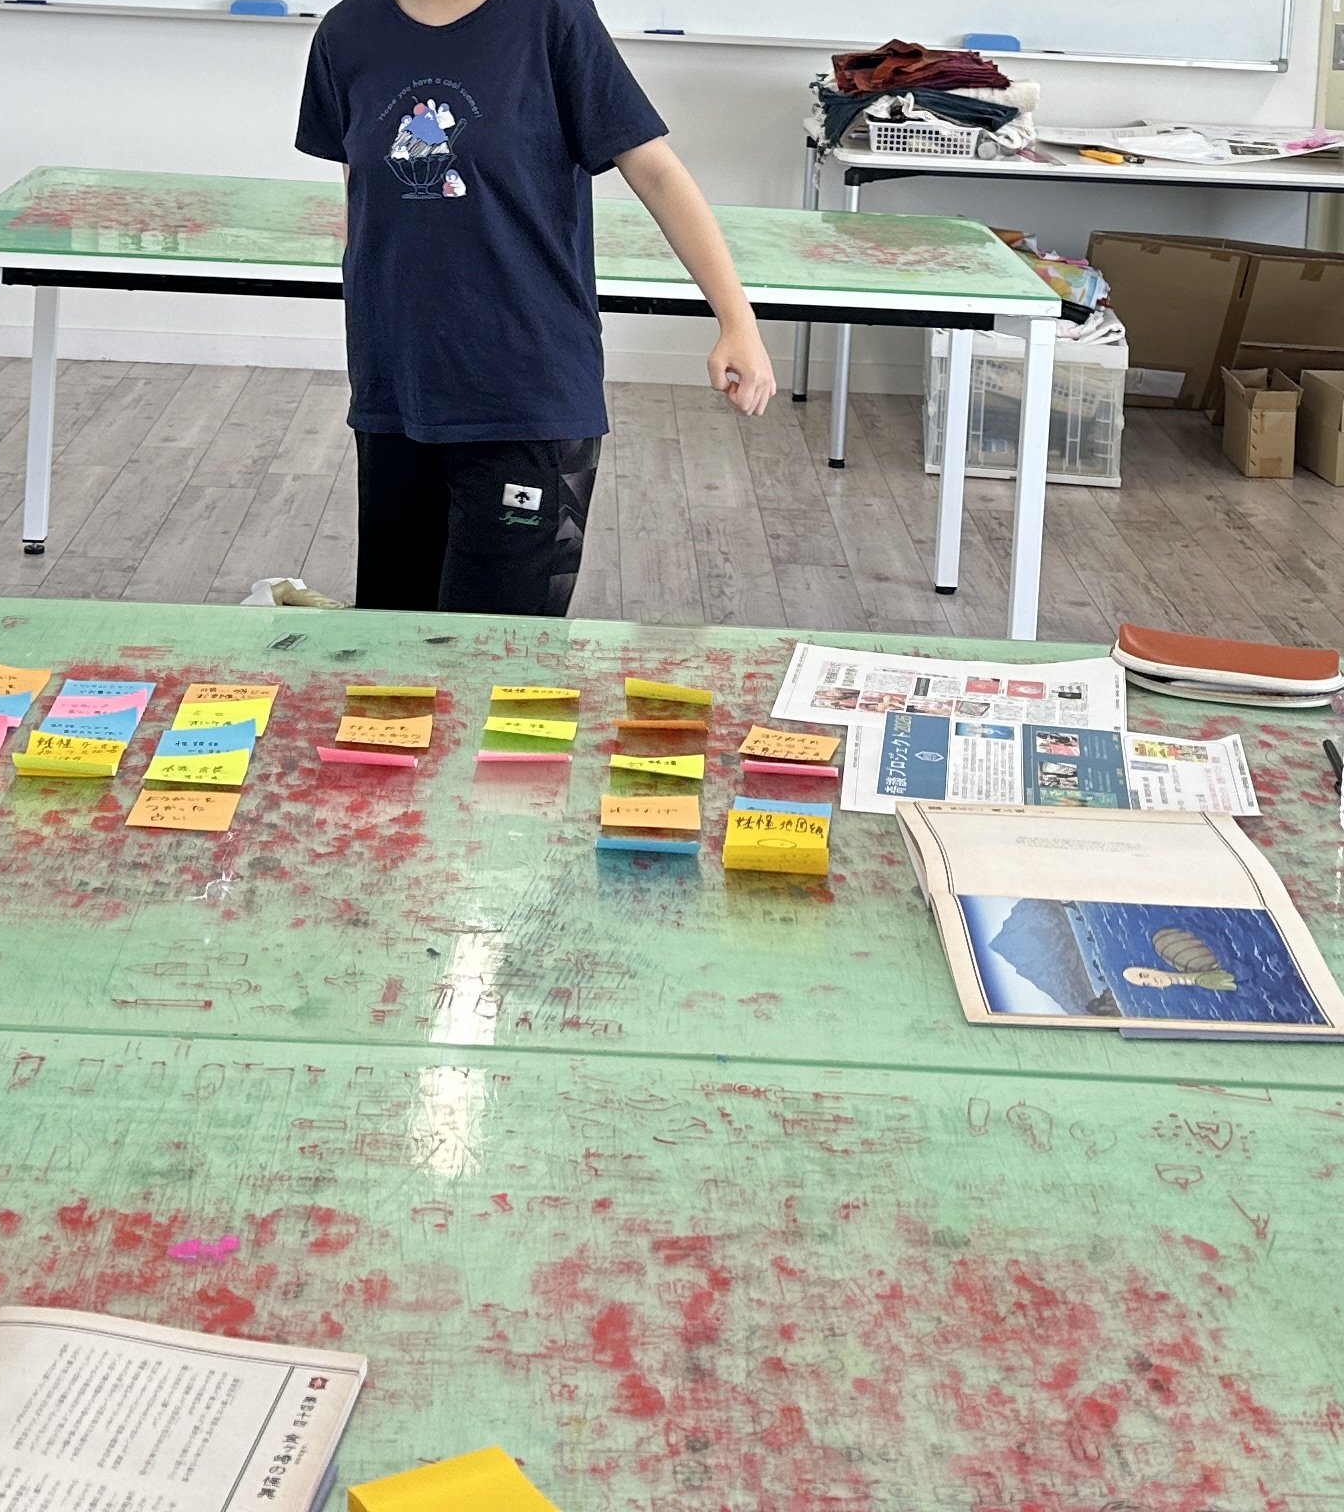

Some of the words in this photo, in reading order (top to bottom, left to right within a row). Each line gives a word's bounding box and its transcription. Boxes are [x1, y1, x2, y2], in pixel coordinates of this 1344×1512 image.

[377, 101, 397, 121] Hope
[399, 87, 412, 100] you
[412, 77, 433, 88] have
[443, 80, 462, 90] cool
